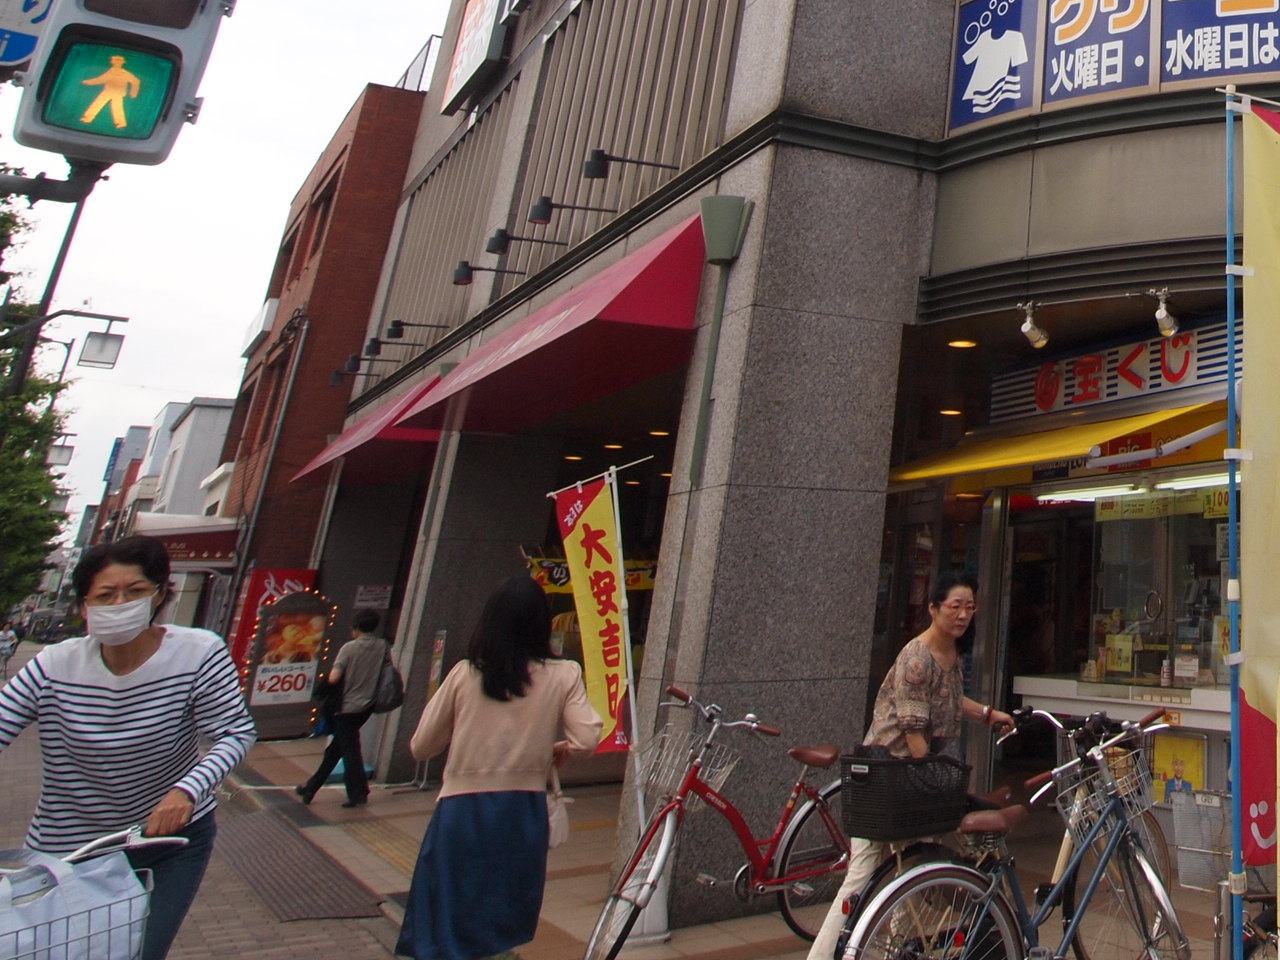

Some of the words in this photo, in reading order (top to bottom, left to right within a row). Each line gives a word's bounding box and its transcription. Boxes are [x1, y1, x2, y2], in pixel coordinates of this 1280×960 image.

[1072, 331, 1195, 403] 宝くじ
[580, 522, 621, 720] 大安吉日
